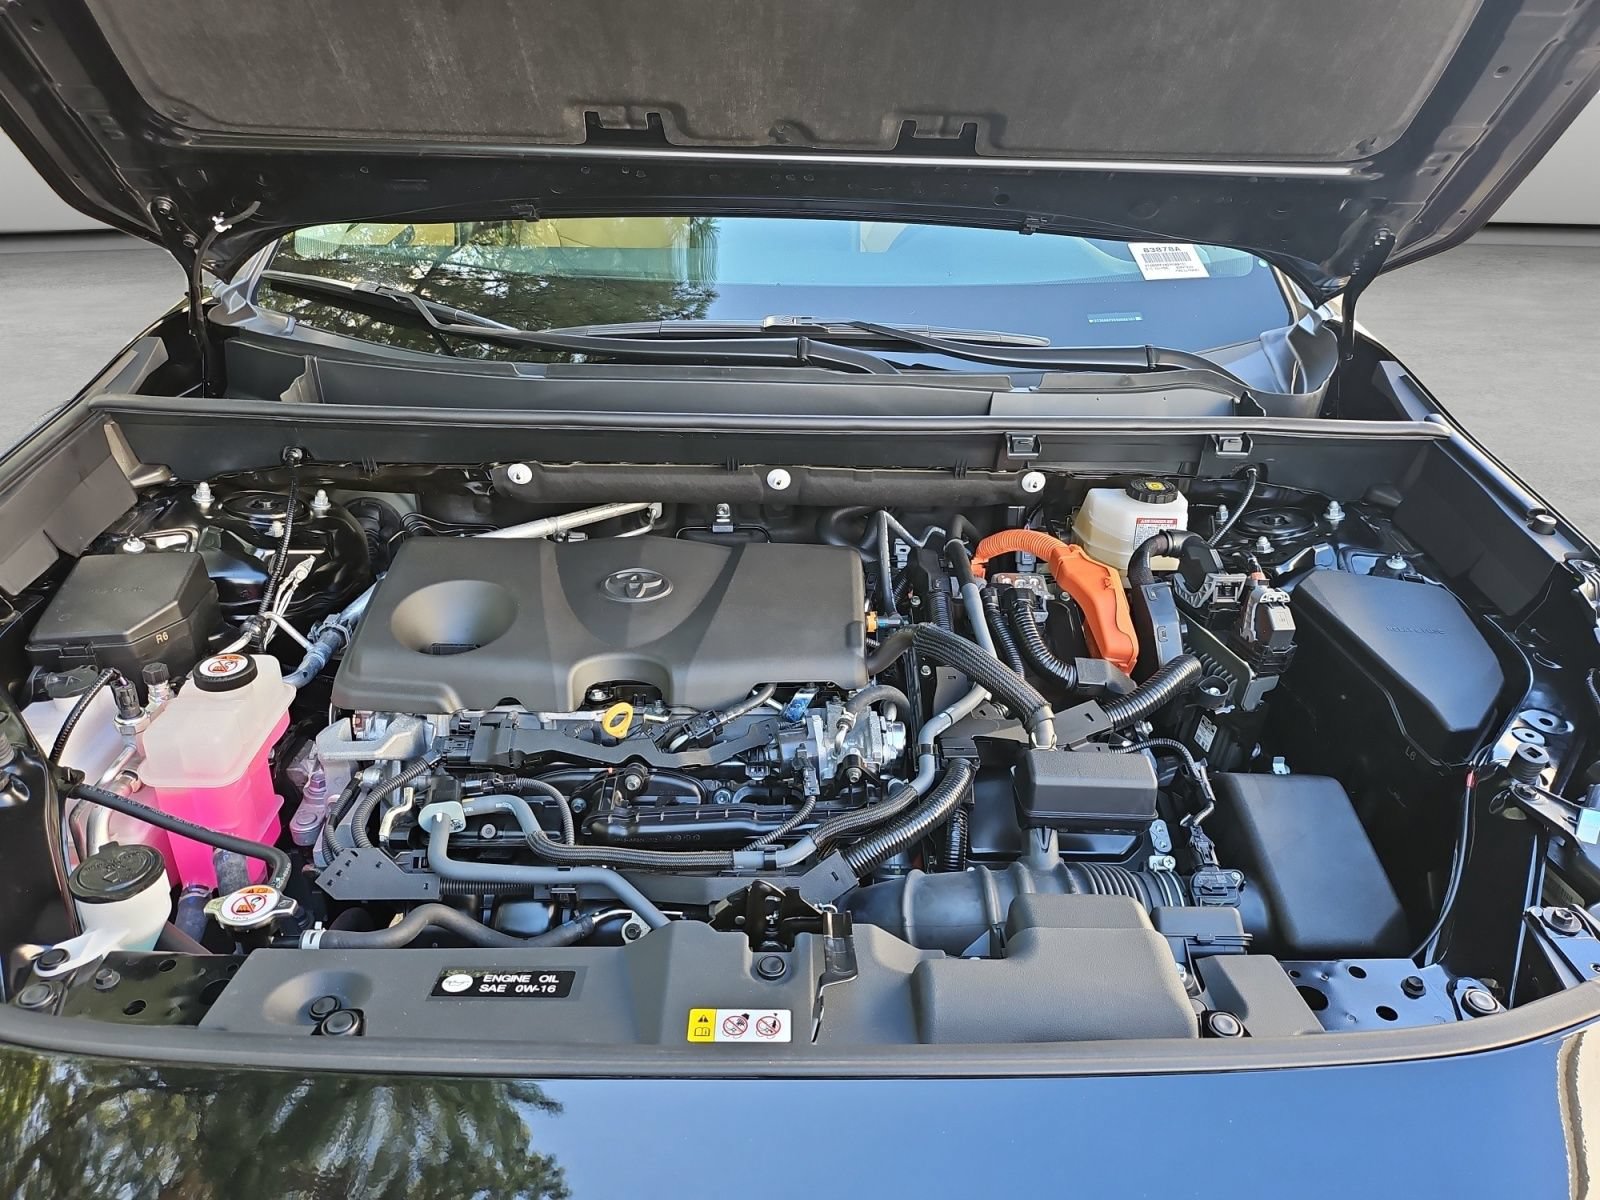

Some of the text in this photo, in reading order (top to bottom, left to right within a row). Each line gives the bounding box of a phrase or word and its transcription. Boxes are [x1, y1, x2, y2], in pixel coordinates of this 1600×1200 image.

[155, 631, 169, 644] R6
[482, 974, 560, 983] ENGINE OIL
[478, 984, 557, 993] SAE 0W-16
